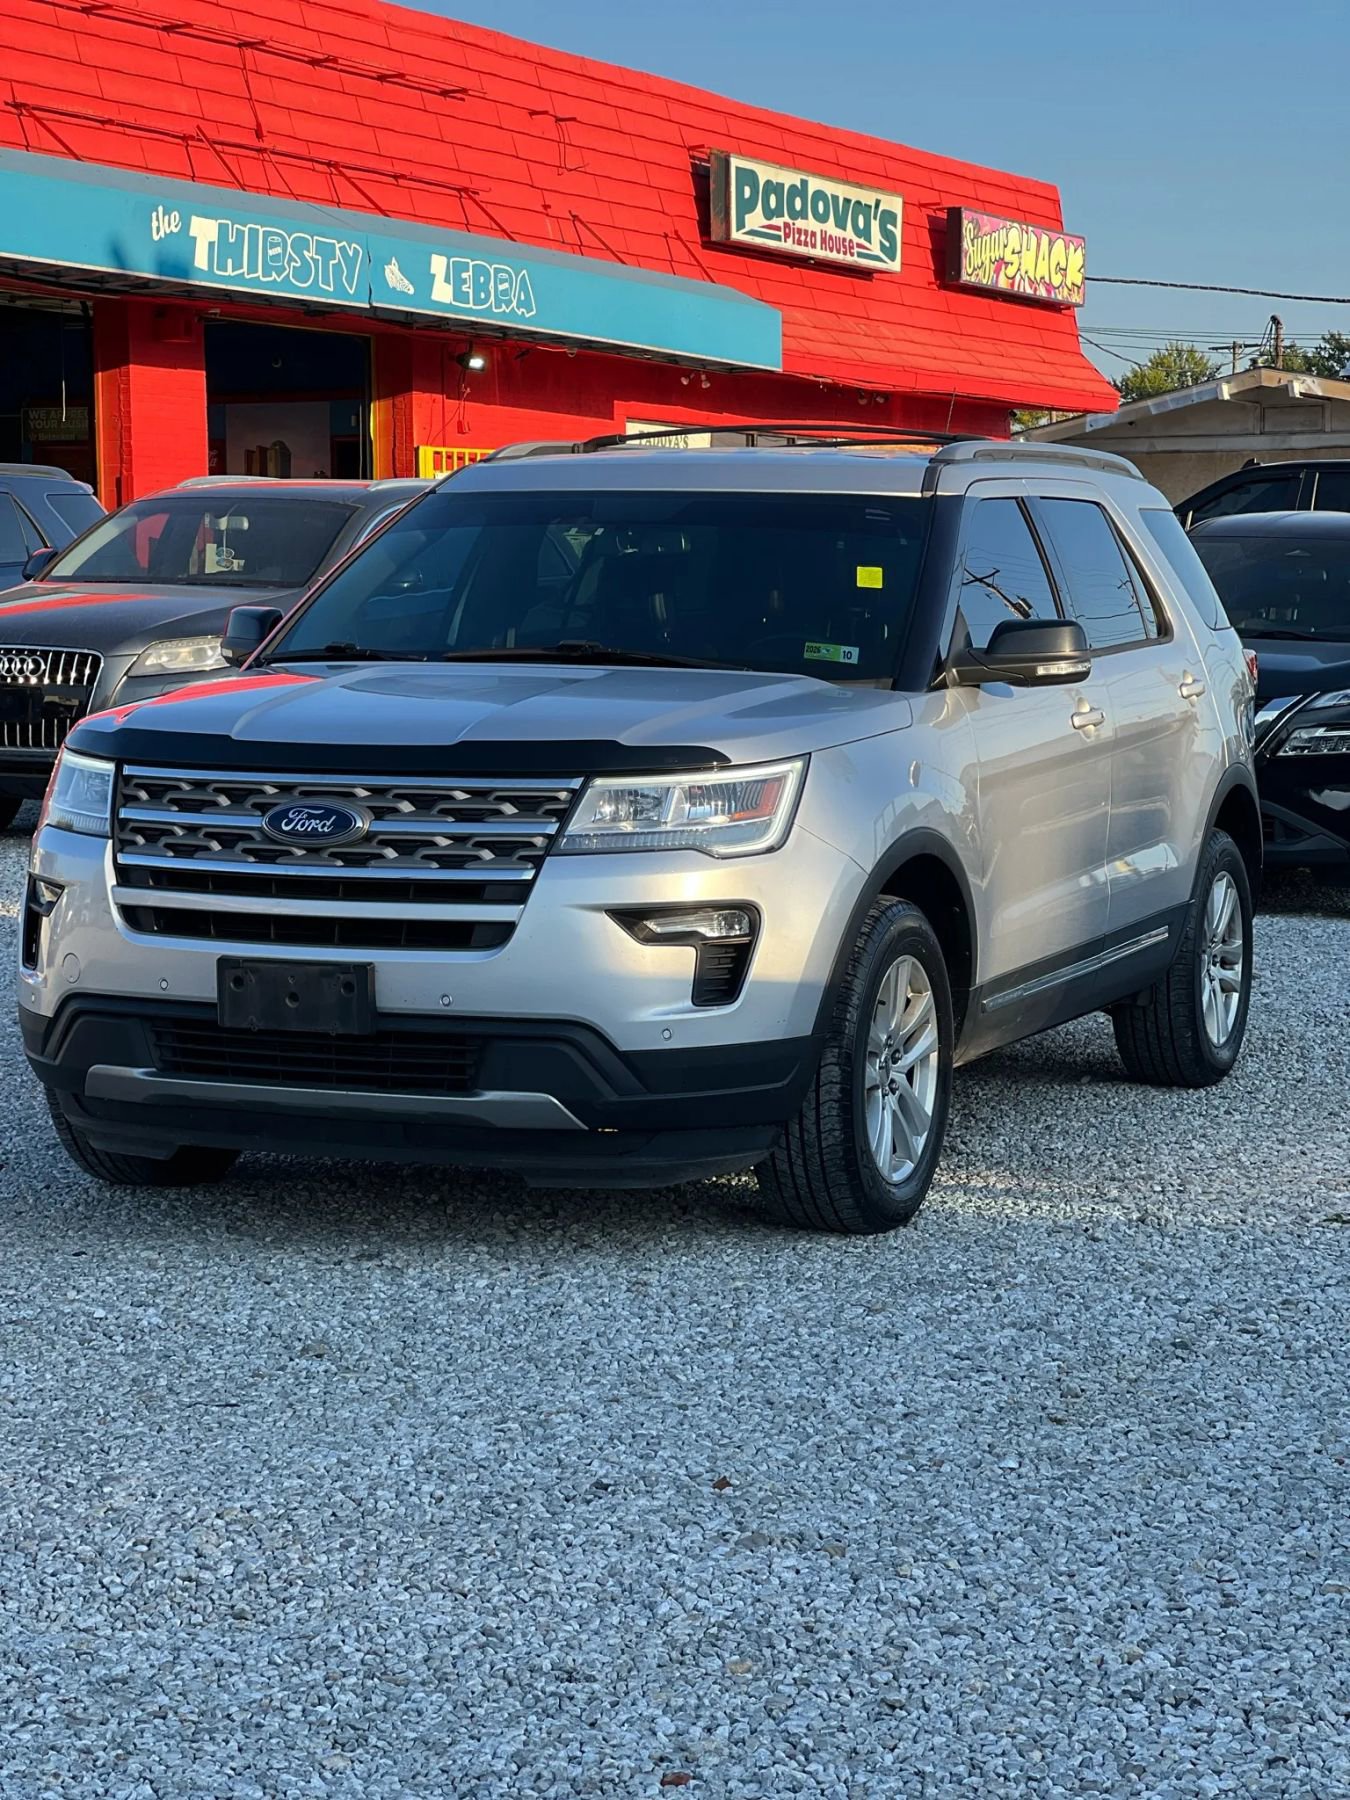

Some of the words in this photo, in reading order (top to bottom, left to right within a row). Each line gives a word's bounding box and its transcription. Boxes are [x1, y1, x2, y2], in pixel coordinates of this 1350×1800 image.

[735, 166, 898, 263] Padova's
[783, 221, 817, 249] Pizza
[820, 229, 856, 258] House
[152, 205, 182, 241] the
[189, 215, 363, 295] THIRSTY
[430, 253, 536, 317] ZEBRA
[965, 221, 1008, 285] Sugar
[1004, 226, 1084, 291] SHACK
[842, 650, 852, 660] 10
[281, 808, 337, 832] Ford
